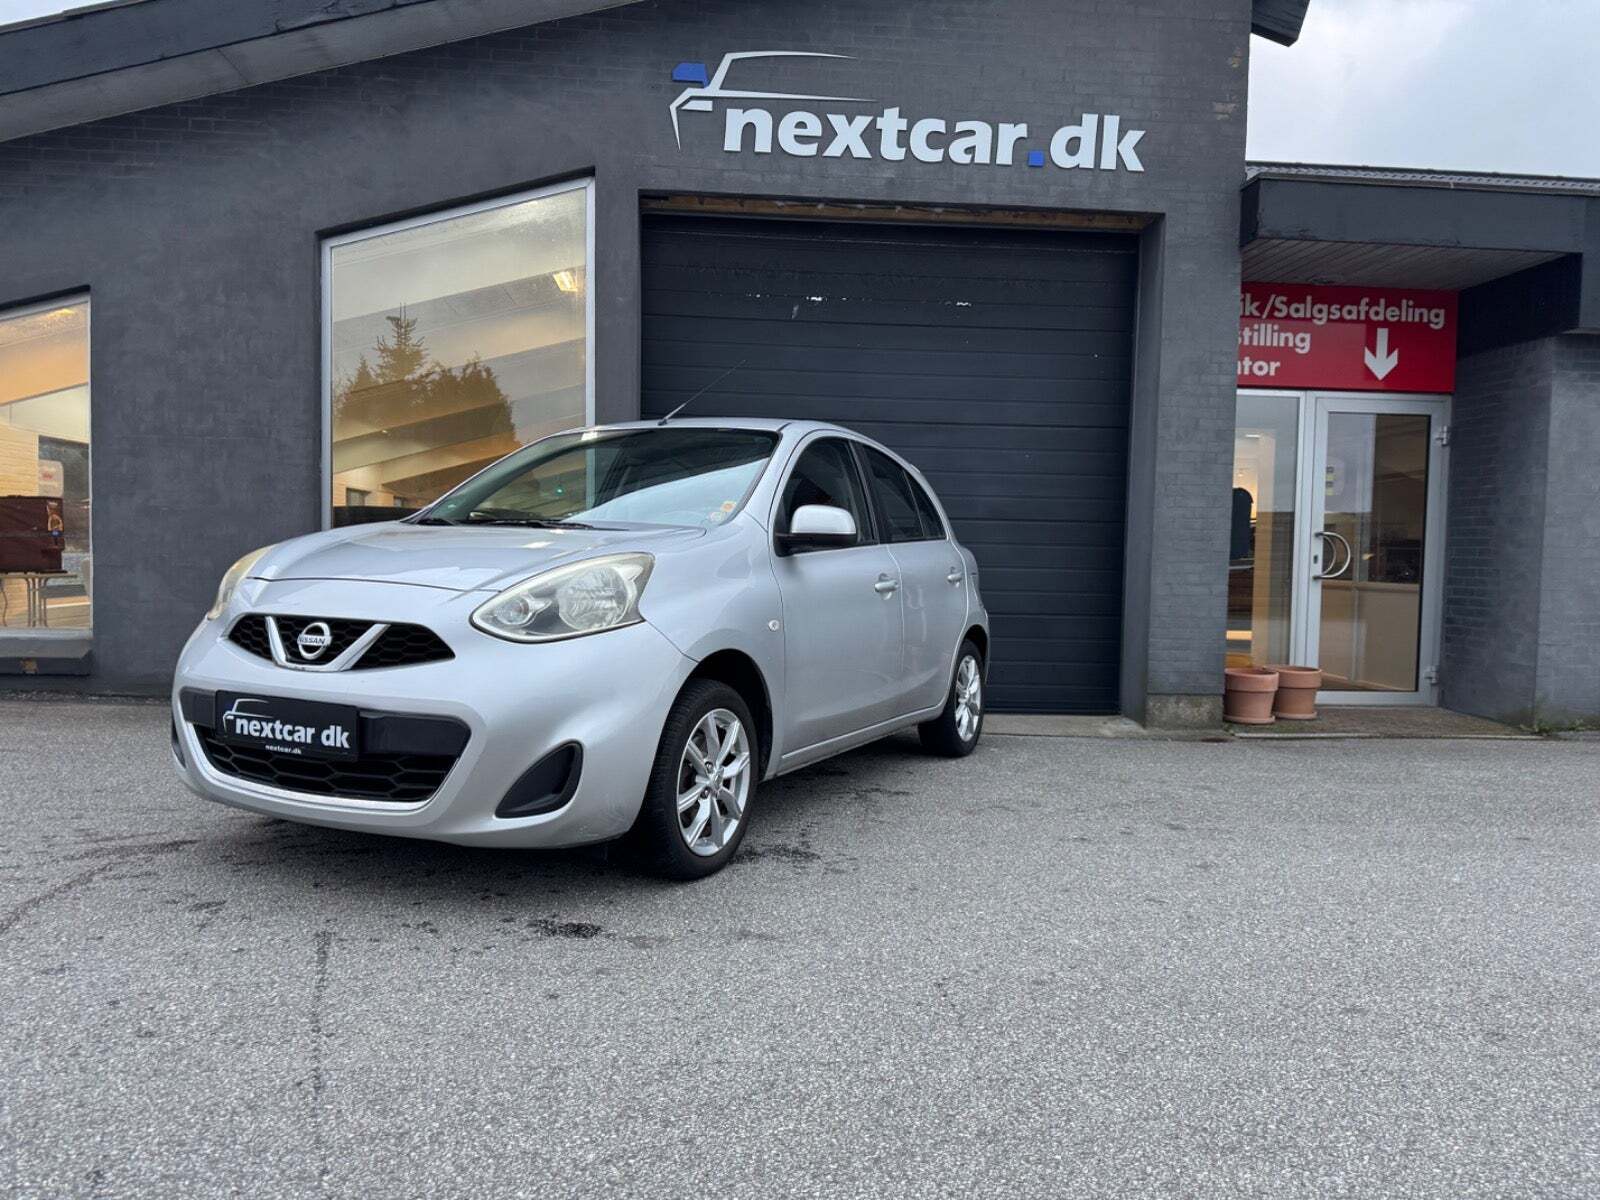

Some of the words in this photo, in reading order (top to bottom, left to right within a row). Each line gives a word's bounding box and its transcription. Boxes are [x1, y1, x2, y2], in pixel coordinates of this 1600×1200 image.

[723, 106, 1146, 173] nextcar.dk
[1238, 323, 1311, 354] tilling
[299, 635, 326, 646] NISSAN
[235, 717, 315, 744] nextcar
[321, 724, 350, 748] dk
